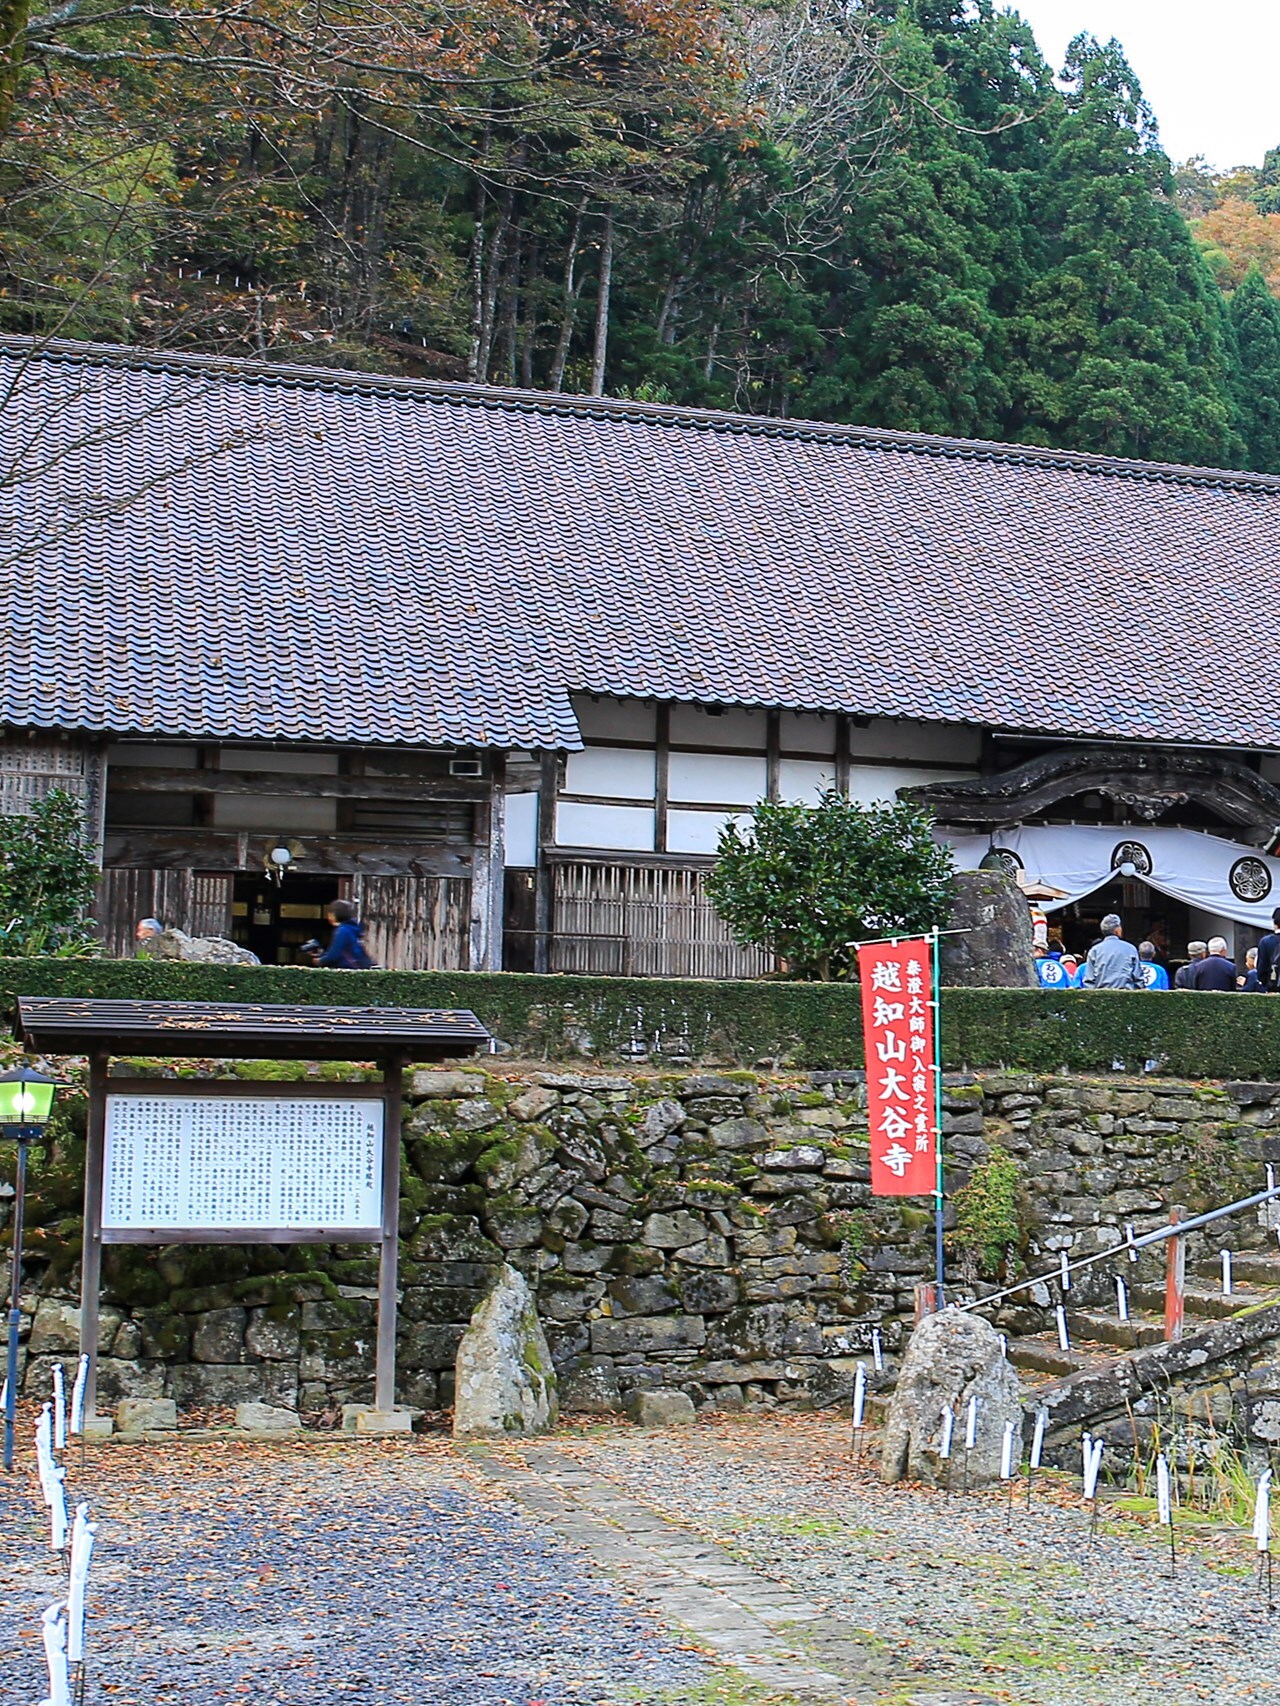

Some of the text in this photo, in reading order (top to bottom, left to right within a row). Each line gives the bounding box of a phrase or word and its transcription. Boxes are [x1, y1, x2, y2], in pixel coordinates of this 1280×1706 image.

[871, 960, 914, 1177] 越知山大谷寺
